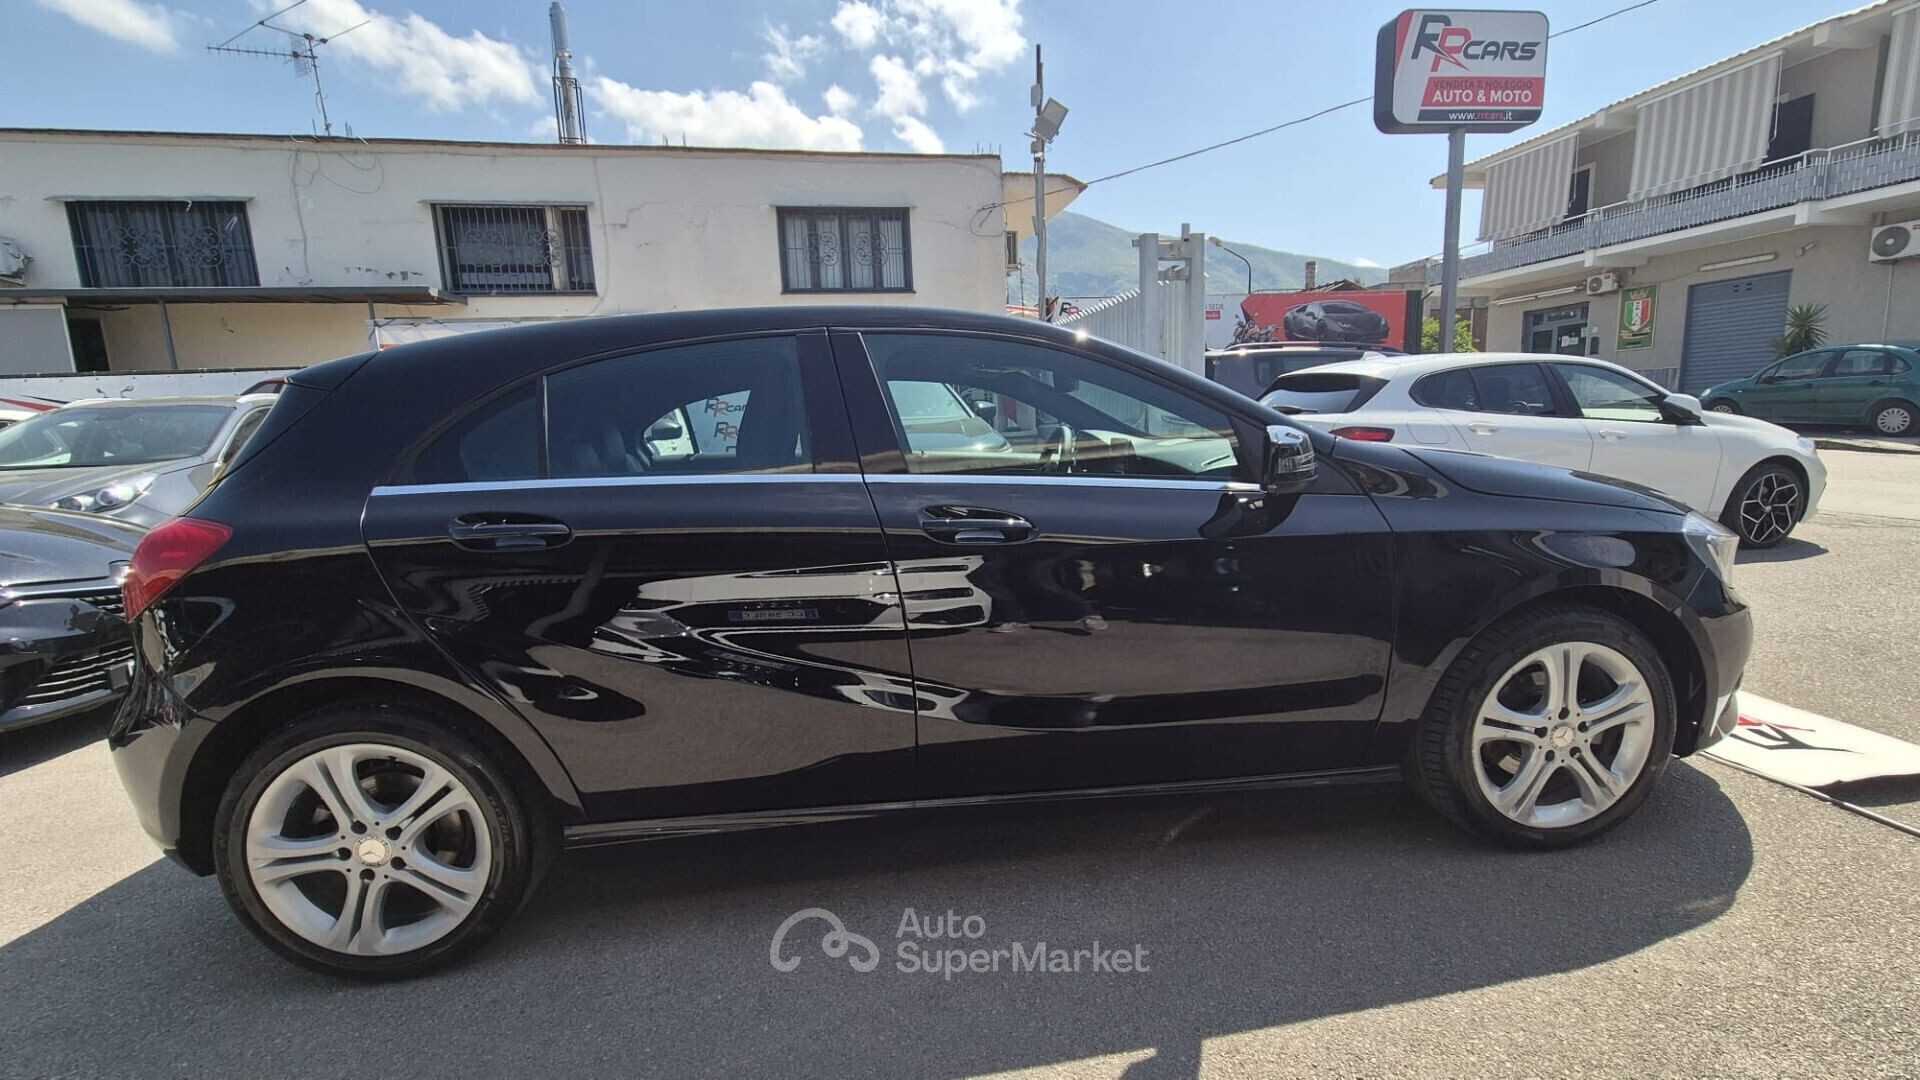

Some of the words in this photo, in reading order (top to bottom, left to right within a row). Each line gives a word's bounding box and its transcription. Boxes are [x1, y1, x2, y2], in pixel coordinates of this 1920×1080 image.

[1433, 79, 1474, 88] VENDITA
[1476, 79, 1482, 88] E
[1485, 79, 1533, 88] NOLEGGIO
[1432, 90, 1473, 103] AUTO
[1476, 90, 1486, 102] &
[1490, 90, 1532, 102] MOTO
[1448, 110, 1513, 121] www.rrcars.it
